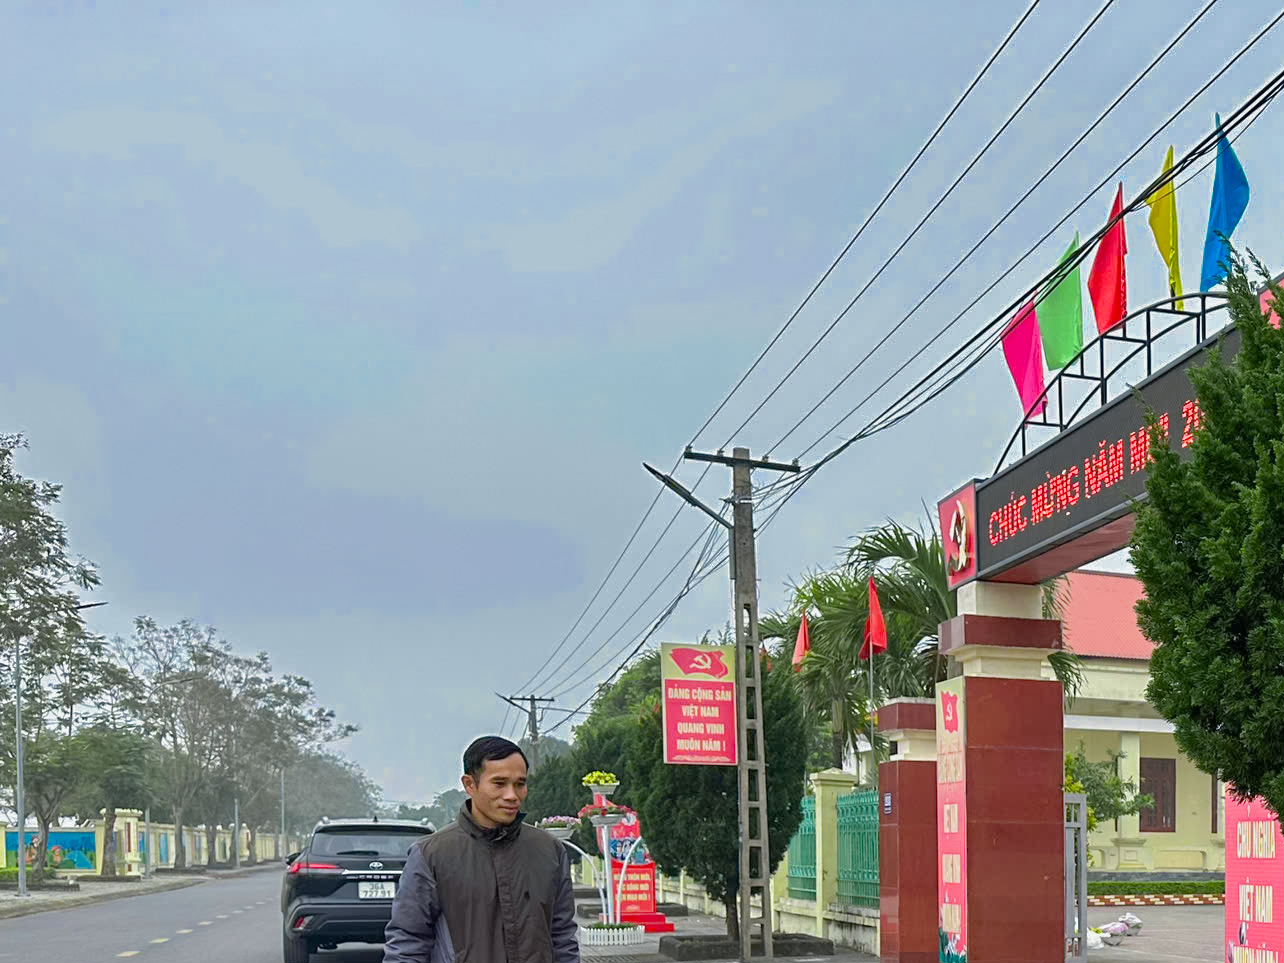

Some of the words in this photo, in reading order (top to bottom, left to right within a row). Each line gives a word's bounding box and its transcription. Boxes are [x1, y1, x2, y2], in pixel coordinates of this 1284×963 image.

[988, 491, 1028, 546] CHÚC
[1084, 439, 1124, 498] NĂM
[668, 683, 690, 699] ĐẢNG
[692, 687, 713, 702] CỘNG
[715, 686, 732, 701] SẢN
[681, 703, 698, 719] VIỆT
[701, 706, 719, 717] NAM
[677, 722, 704, 734] QUANG
[706, 724, 724, 734] VINH
[676, 737, 700, 751] MUÔN
[702, 738, 721, 751] NĂM
[1239, 877, 1254, 928] VIỆT
[1255, 885, 1273, 923] NAM
